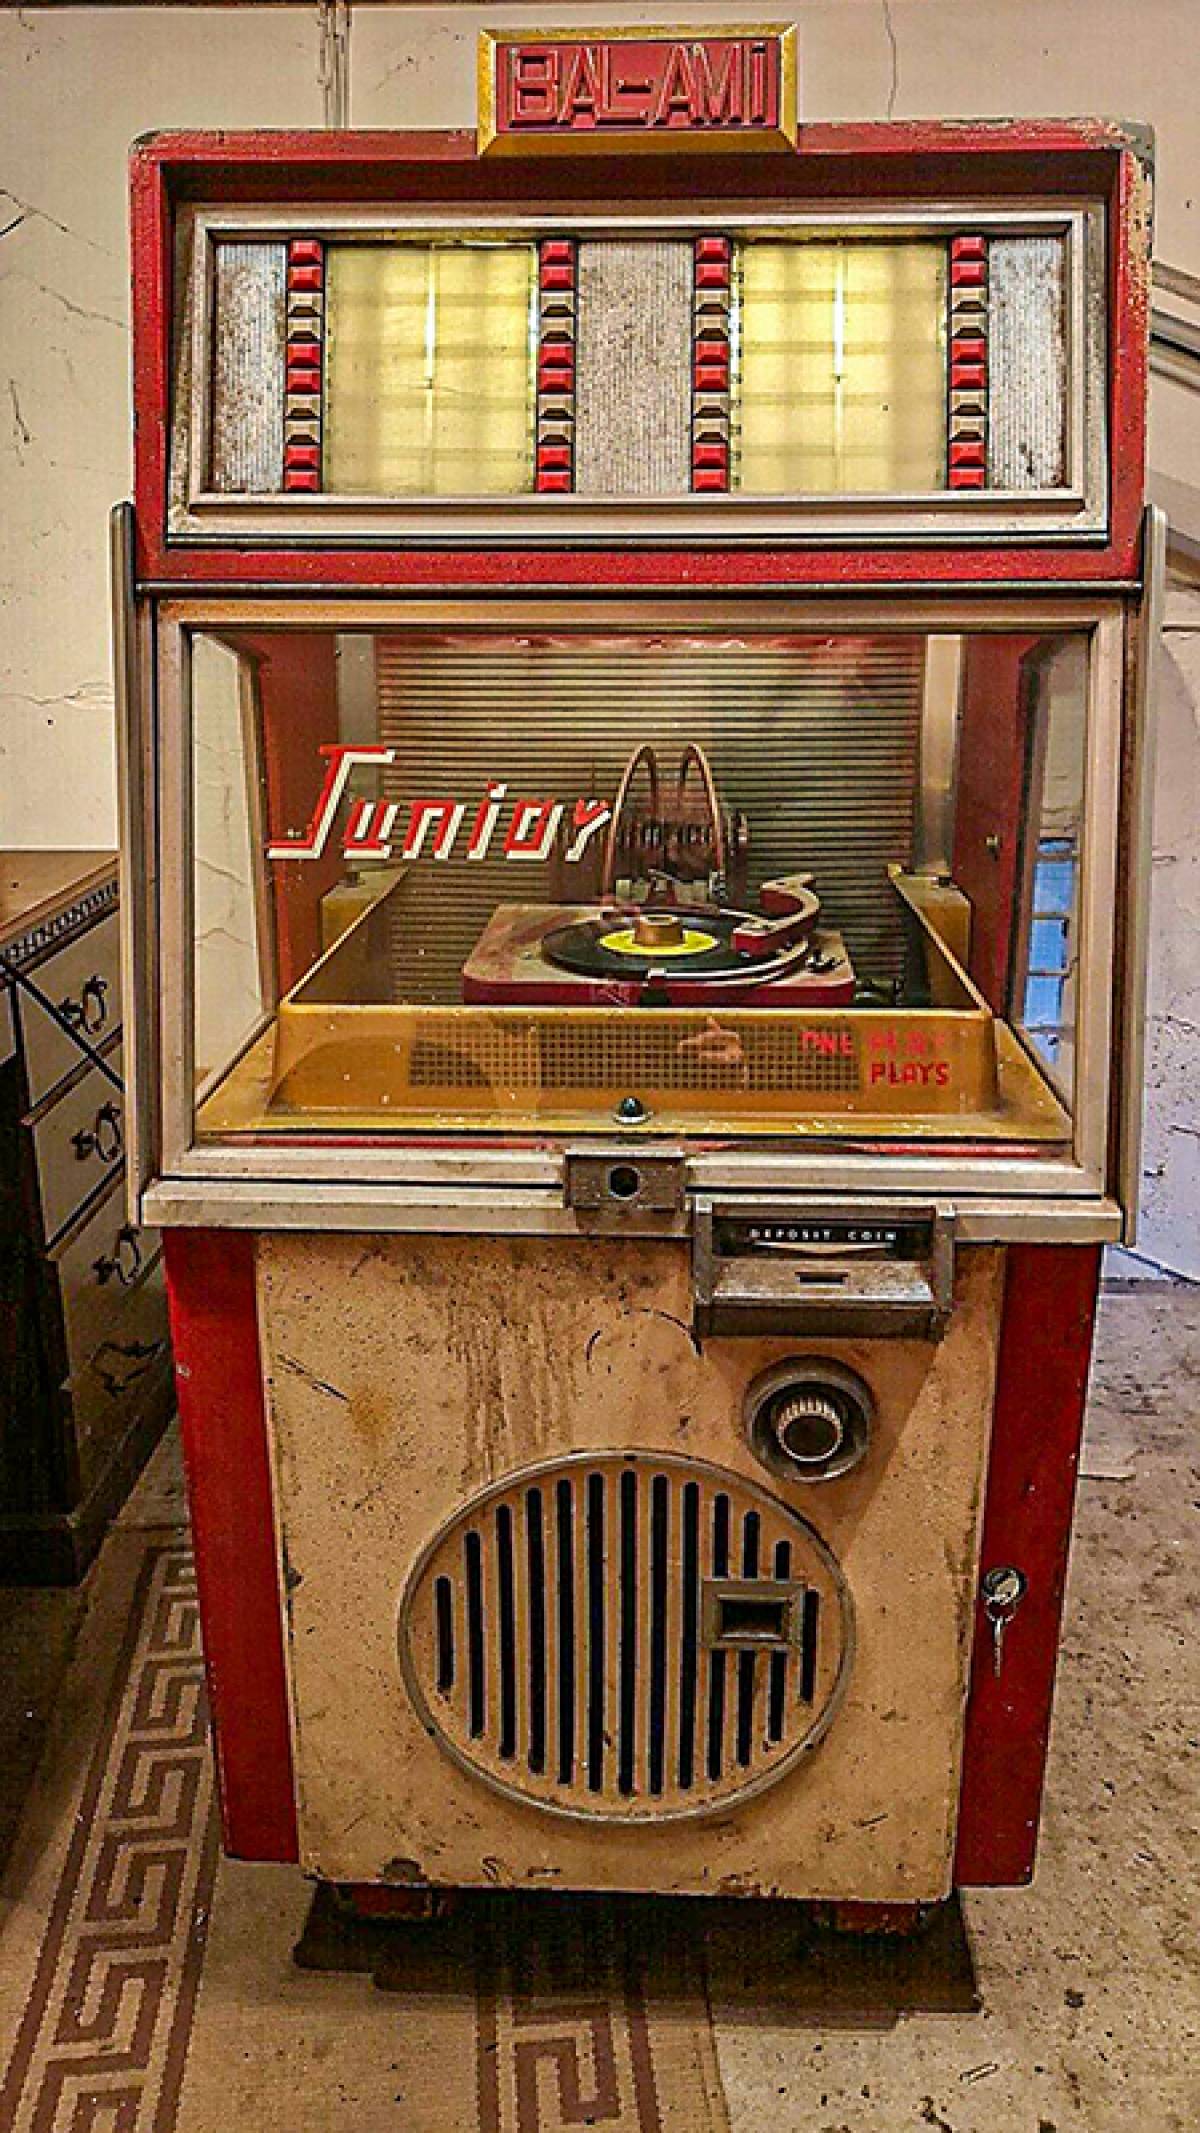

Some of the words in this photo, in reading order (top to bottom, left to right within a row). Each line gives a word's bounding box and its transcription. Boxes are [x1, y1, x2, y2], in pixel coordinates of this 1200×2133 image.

[870, 1062, 950, 1086] PLAYS
[749, 1228, 831, 1241] DEPOSIT
[847, 1230, 897, 1241] COIN
